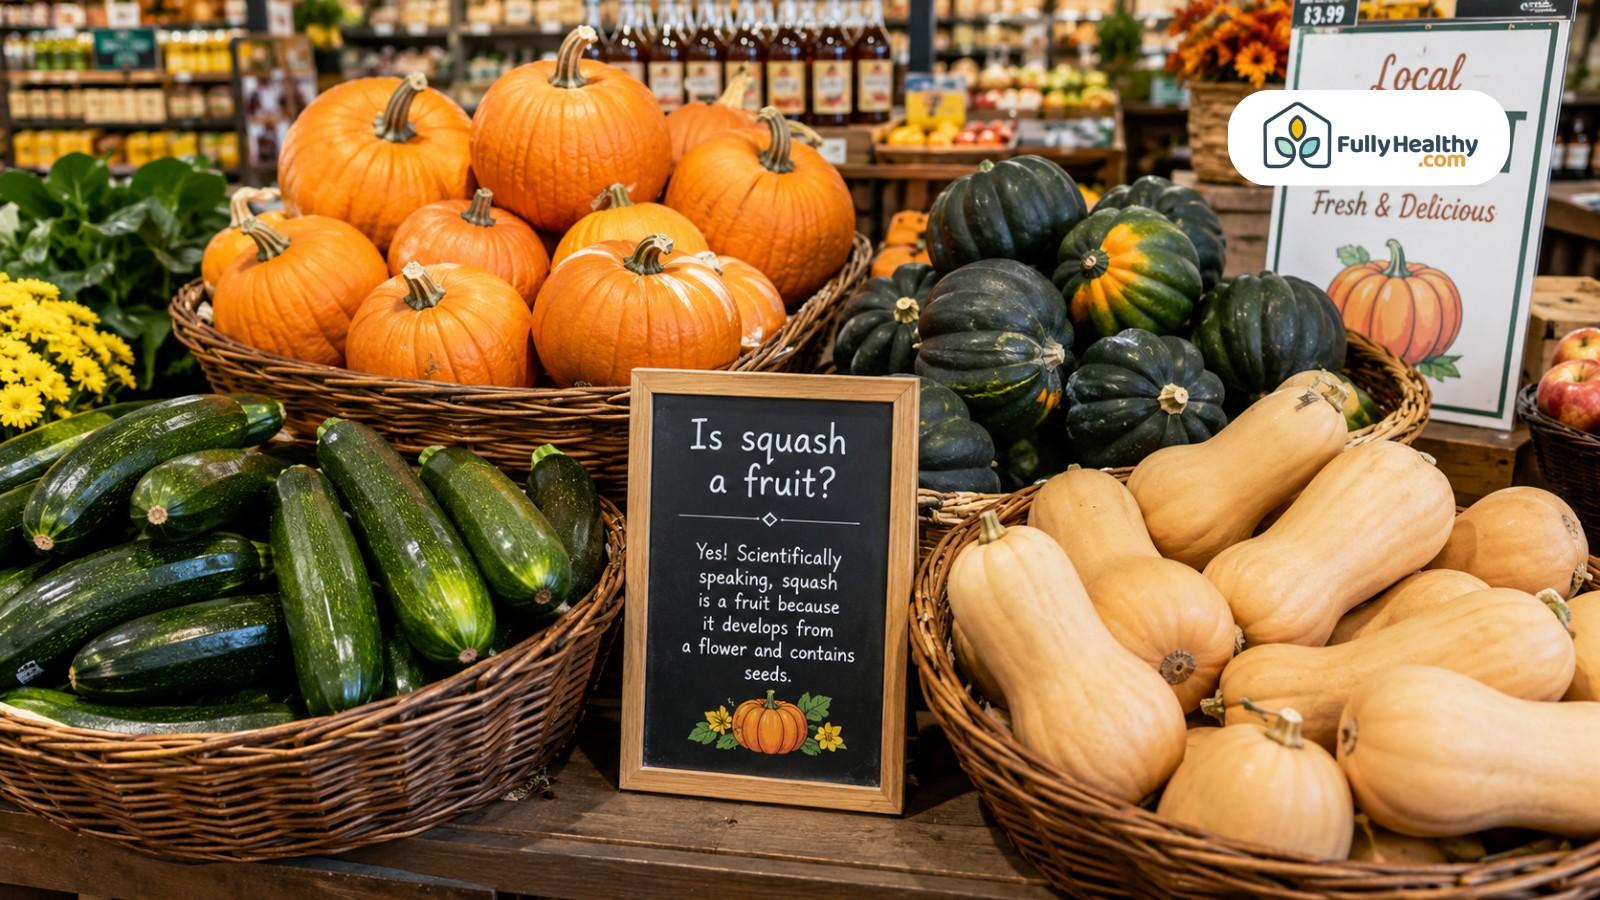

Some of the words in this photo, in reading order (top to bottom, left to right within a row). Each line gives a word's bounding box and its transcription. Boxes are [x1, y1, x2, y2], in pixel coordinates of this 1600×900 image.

[1370, 53, 1467, 90] Local
[1312, 190, 1367, 217] Fresh
[1375, 193, 1391, 218] &
[1399, 193, 1496, 223] Delicious
[690, 418, 723, 451] Is
[741, 422, 846, 466] squash
[709, 474, 728, 494] a
[744, 463, 836, 499] fruit?
[696, 542, 728, 561] Yes!
[737, 544, 842, 573] Scientifically
[699, 568, 773, 594] speaking,
[782, 573, 838, 595] squash
[699, 593, 710, 608] is
[718, 598, 727, 609] a
[735, 592, 770, 611] fruit
[778, 595, 840, 616] because
[703, 617, 714, 632] it
[723, 618, 789, 641] develops
[797, 619, 834, 638] from
[682, 643, 691, 653] a
[699, 637, 748, 656] flower
[755, 642, 782, 659] and
[790, 645, 855, 663] contains
[744, 665, 792, 683] seeds.
